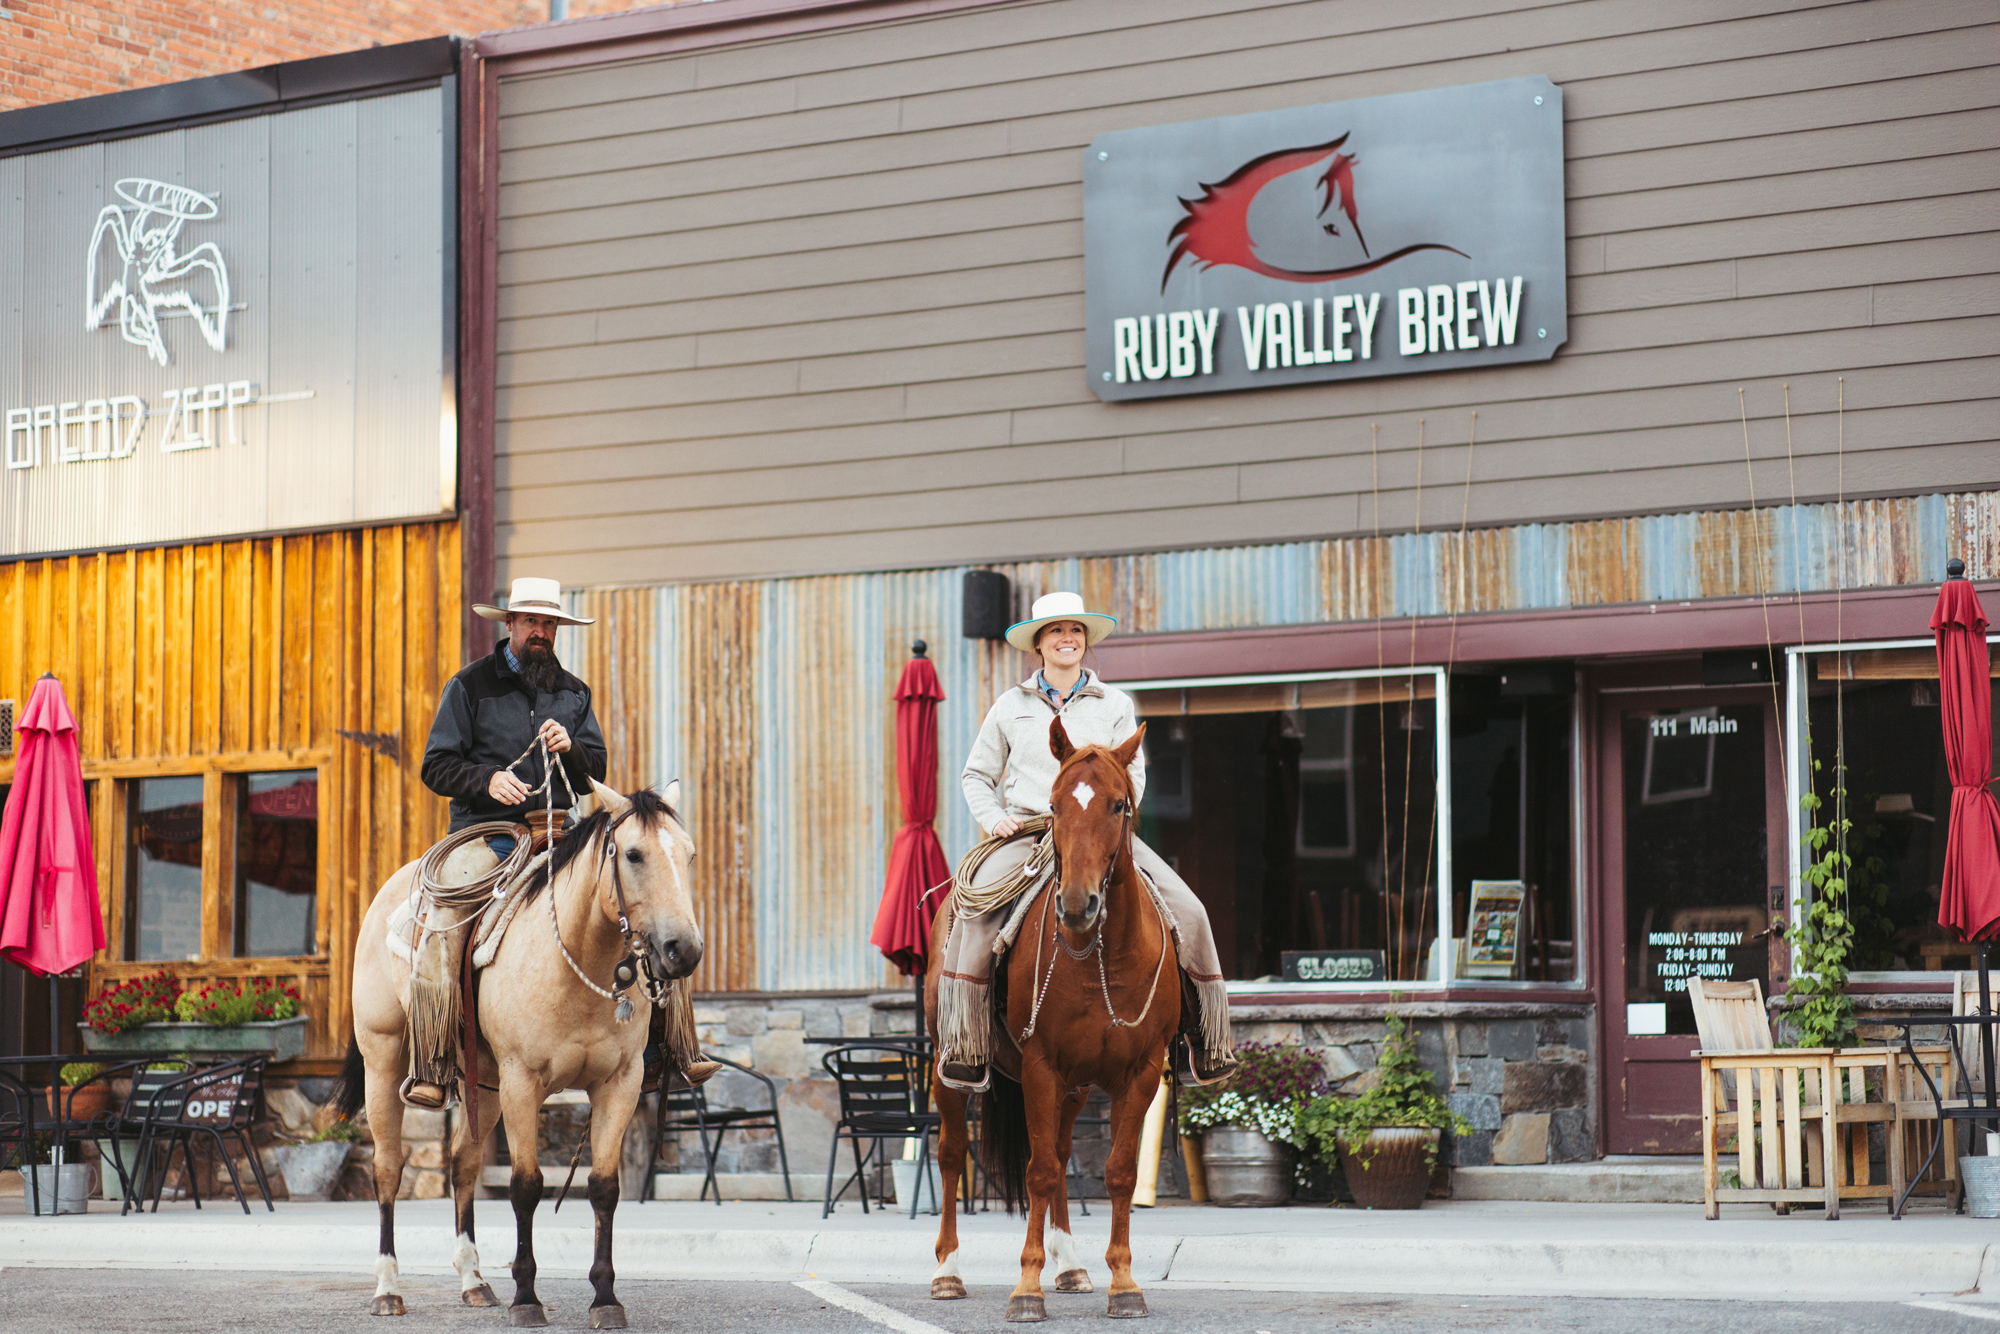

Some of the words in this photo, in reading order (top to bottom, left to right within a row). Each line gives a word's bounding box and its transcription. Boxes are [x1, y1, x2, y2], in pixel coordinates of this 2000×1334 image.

[1114, 307, 1219, 384] RUBY
[1237, 292, 1380, 371] VALLEY
[1398, 276, 1523, 356] BREW
[6, 394, 143, 469] BREAD
[160, 379, 251, 453] ZEPP
[1650, 718, 1677, 737] 111
[1690, 715, 1738, 735] Main
[260, 782, 312, 811] OPEN
[1648, 932, 1743, 946] MONDAY-THURSDAY
[1665, 947, 1708, 961] 2:00-8:00
[1711, 947, 1726, 961] PM
[1297, 957, 1374, 980] CLOSED
[1657, 963, 1734, 977] FRIDAY-SUNDAY
